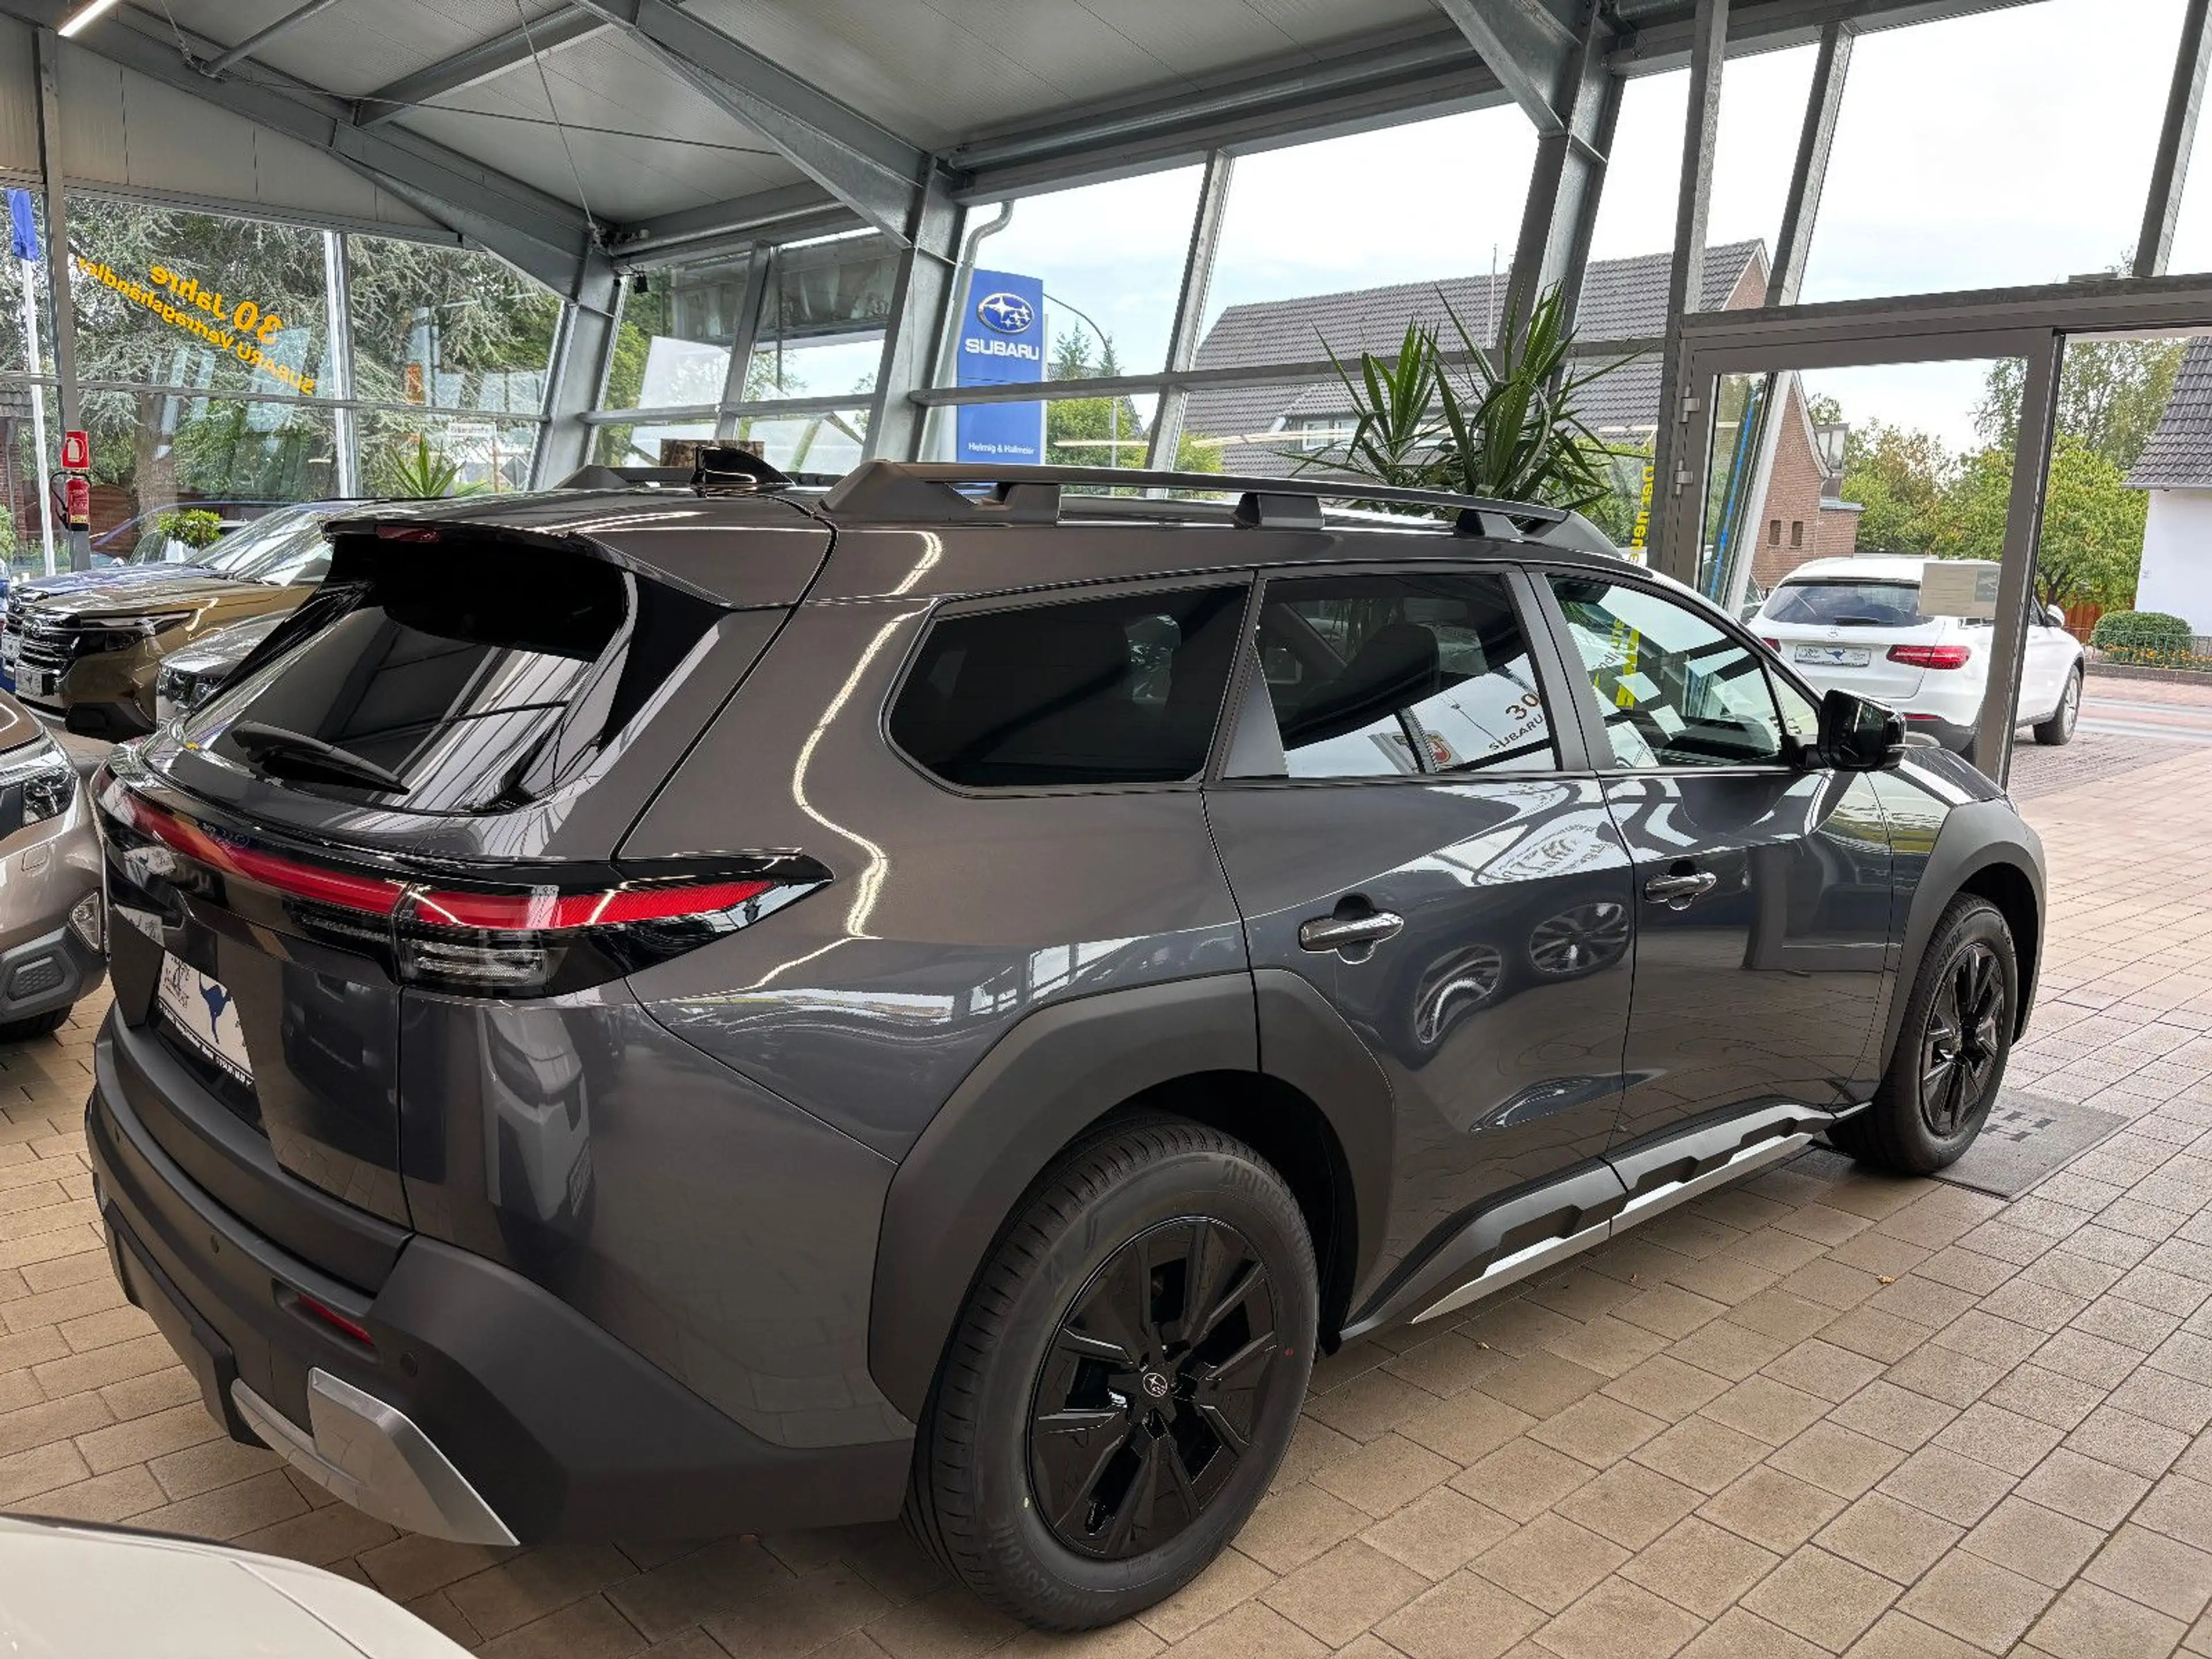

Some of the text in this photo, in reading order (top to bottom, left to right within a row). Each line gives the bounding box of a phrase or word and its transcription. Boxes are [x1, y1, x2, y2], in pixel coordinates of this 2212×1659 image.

[965, 338, 1040, 361] SUBARU
[1505, 692, 1540, 721] 30
[1489, 713, 1544, 752] SUBARU
